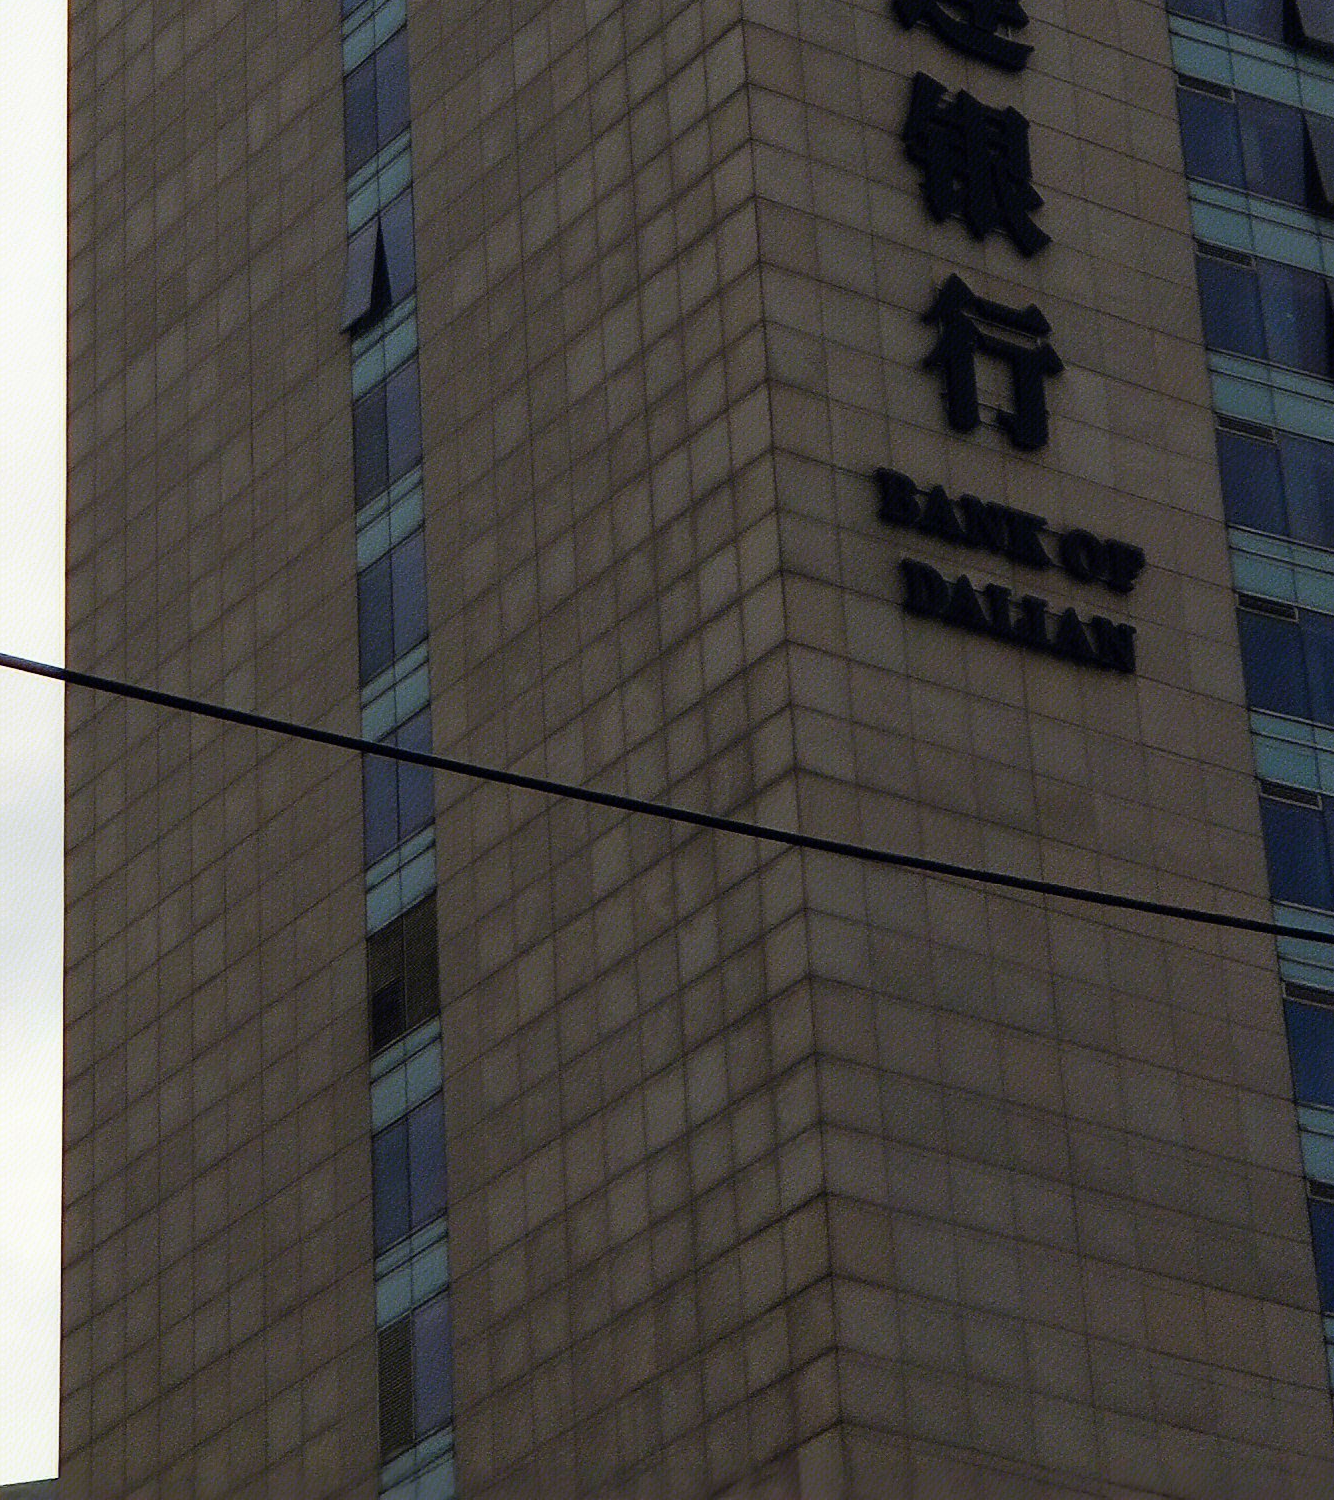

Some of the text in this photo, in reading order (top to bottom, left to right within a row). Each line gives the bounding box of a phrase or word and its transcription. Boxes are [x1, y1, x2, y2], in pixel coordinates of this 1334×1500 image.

[873, 467, 1145, 594] BANK OF
[899, 558, 1137, 673] DALIAN
